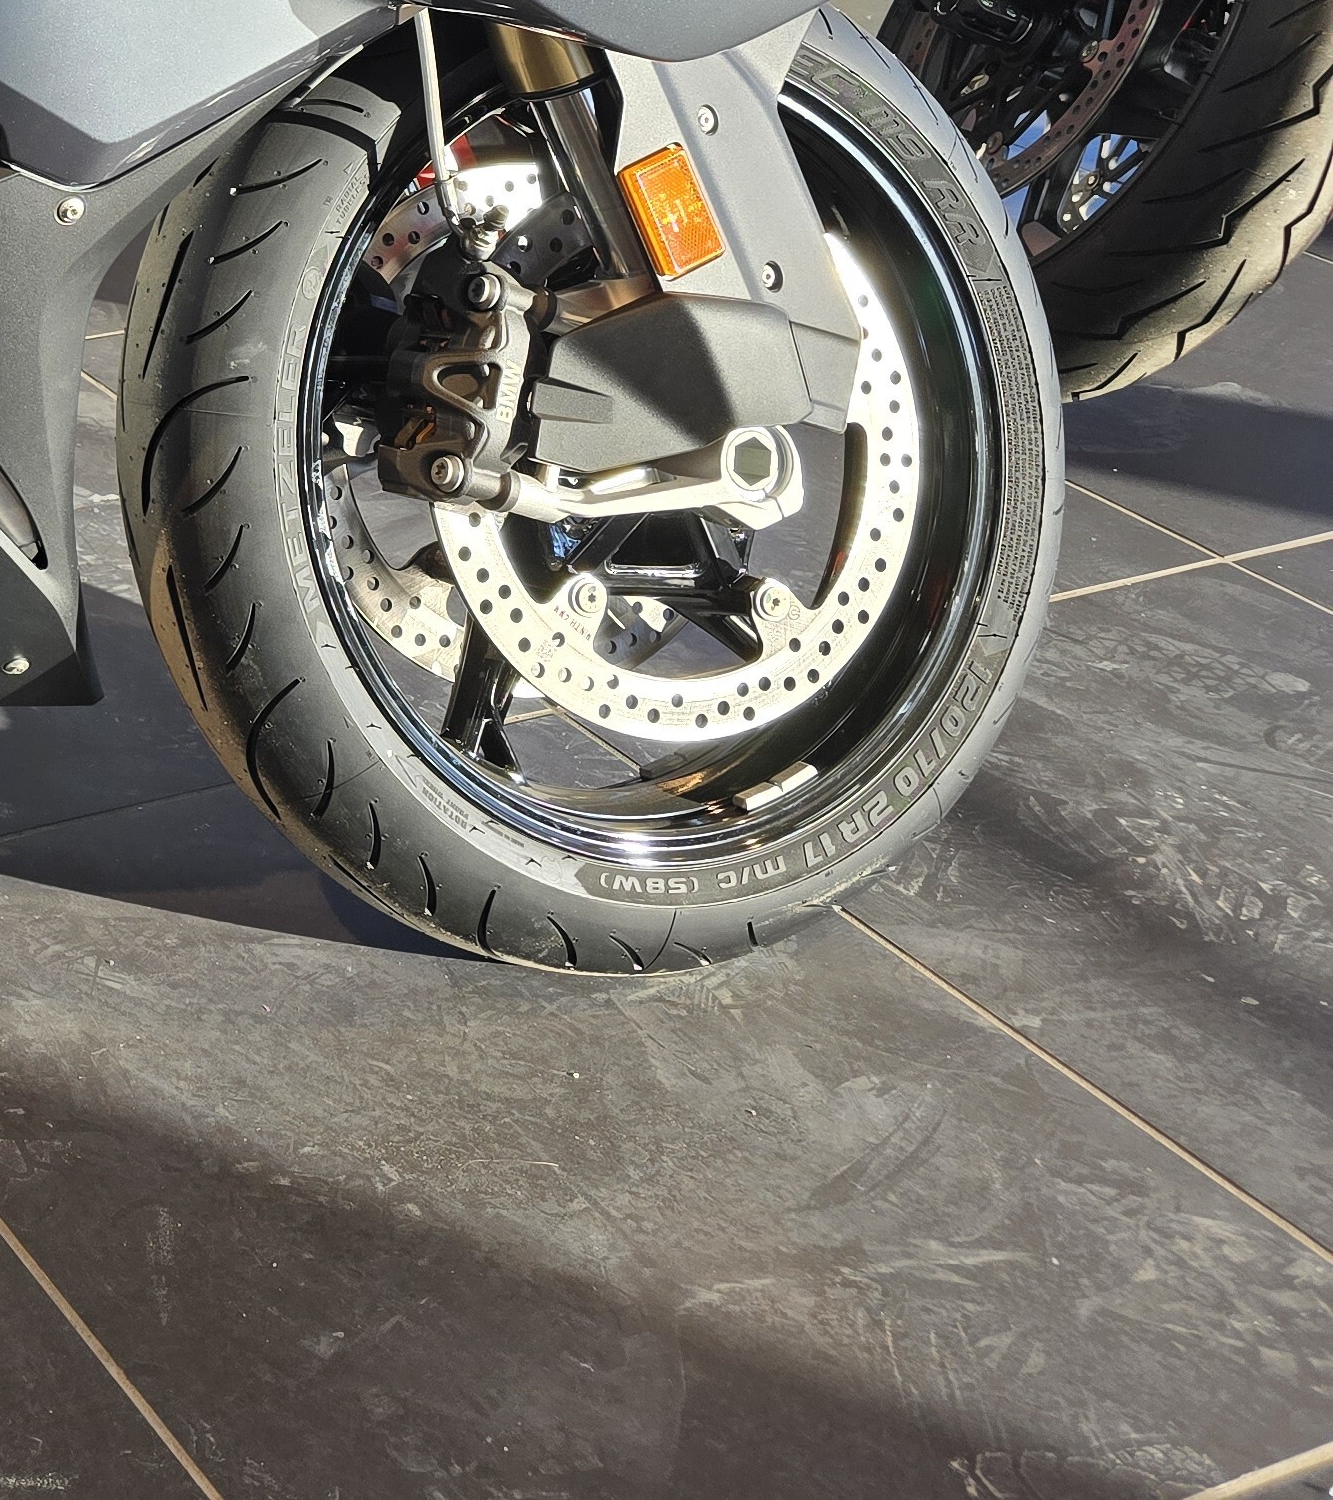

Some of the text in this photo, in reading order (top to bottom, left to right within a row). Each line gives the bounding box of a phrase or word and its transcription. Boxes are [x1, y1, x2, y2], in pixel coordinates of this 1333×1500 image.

[496, 359, 522, 422] BMW
[276, 324, 322, 614] METZELER
[895, 661, 993, 798] 120/70
[421, 786, 468, 831] ROTATION
